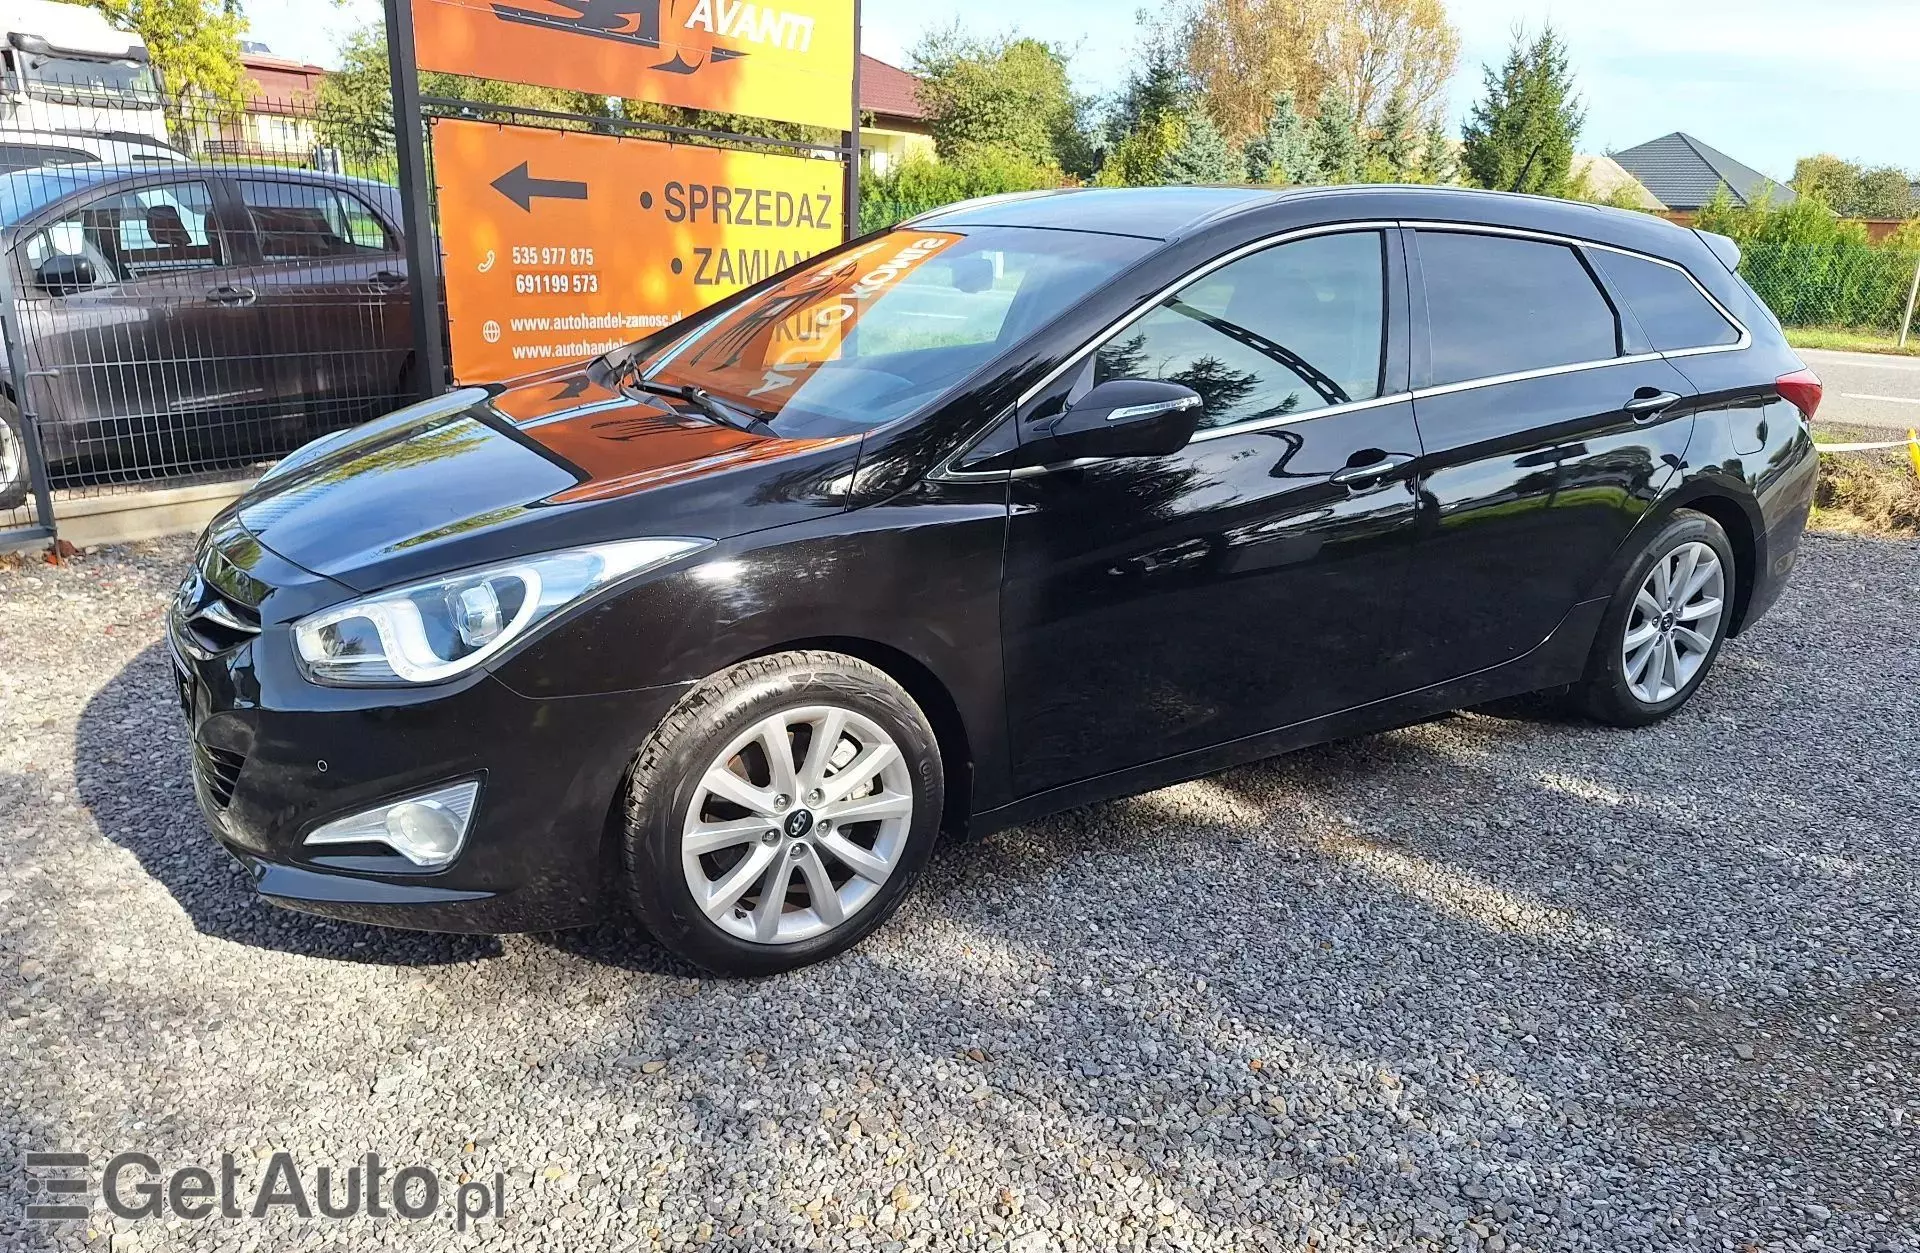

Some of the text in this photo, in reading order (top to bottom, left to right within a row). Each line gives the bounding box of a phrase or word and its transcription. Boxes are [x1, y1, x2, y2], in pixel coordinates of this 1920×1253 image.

[683, 0, 815, 53] AVANTI
[664, 181, 832, 230] SPRZEDAŻ
[512, 246, 594, 266] 535 977 875
[693, 247, 824, 286] ZAMIA
[573, 274, 598, 293] 573
